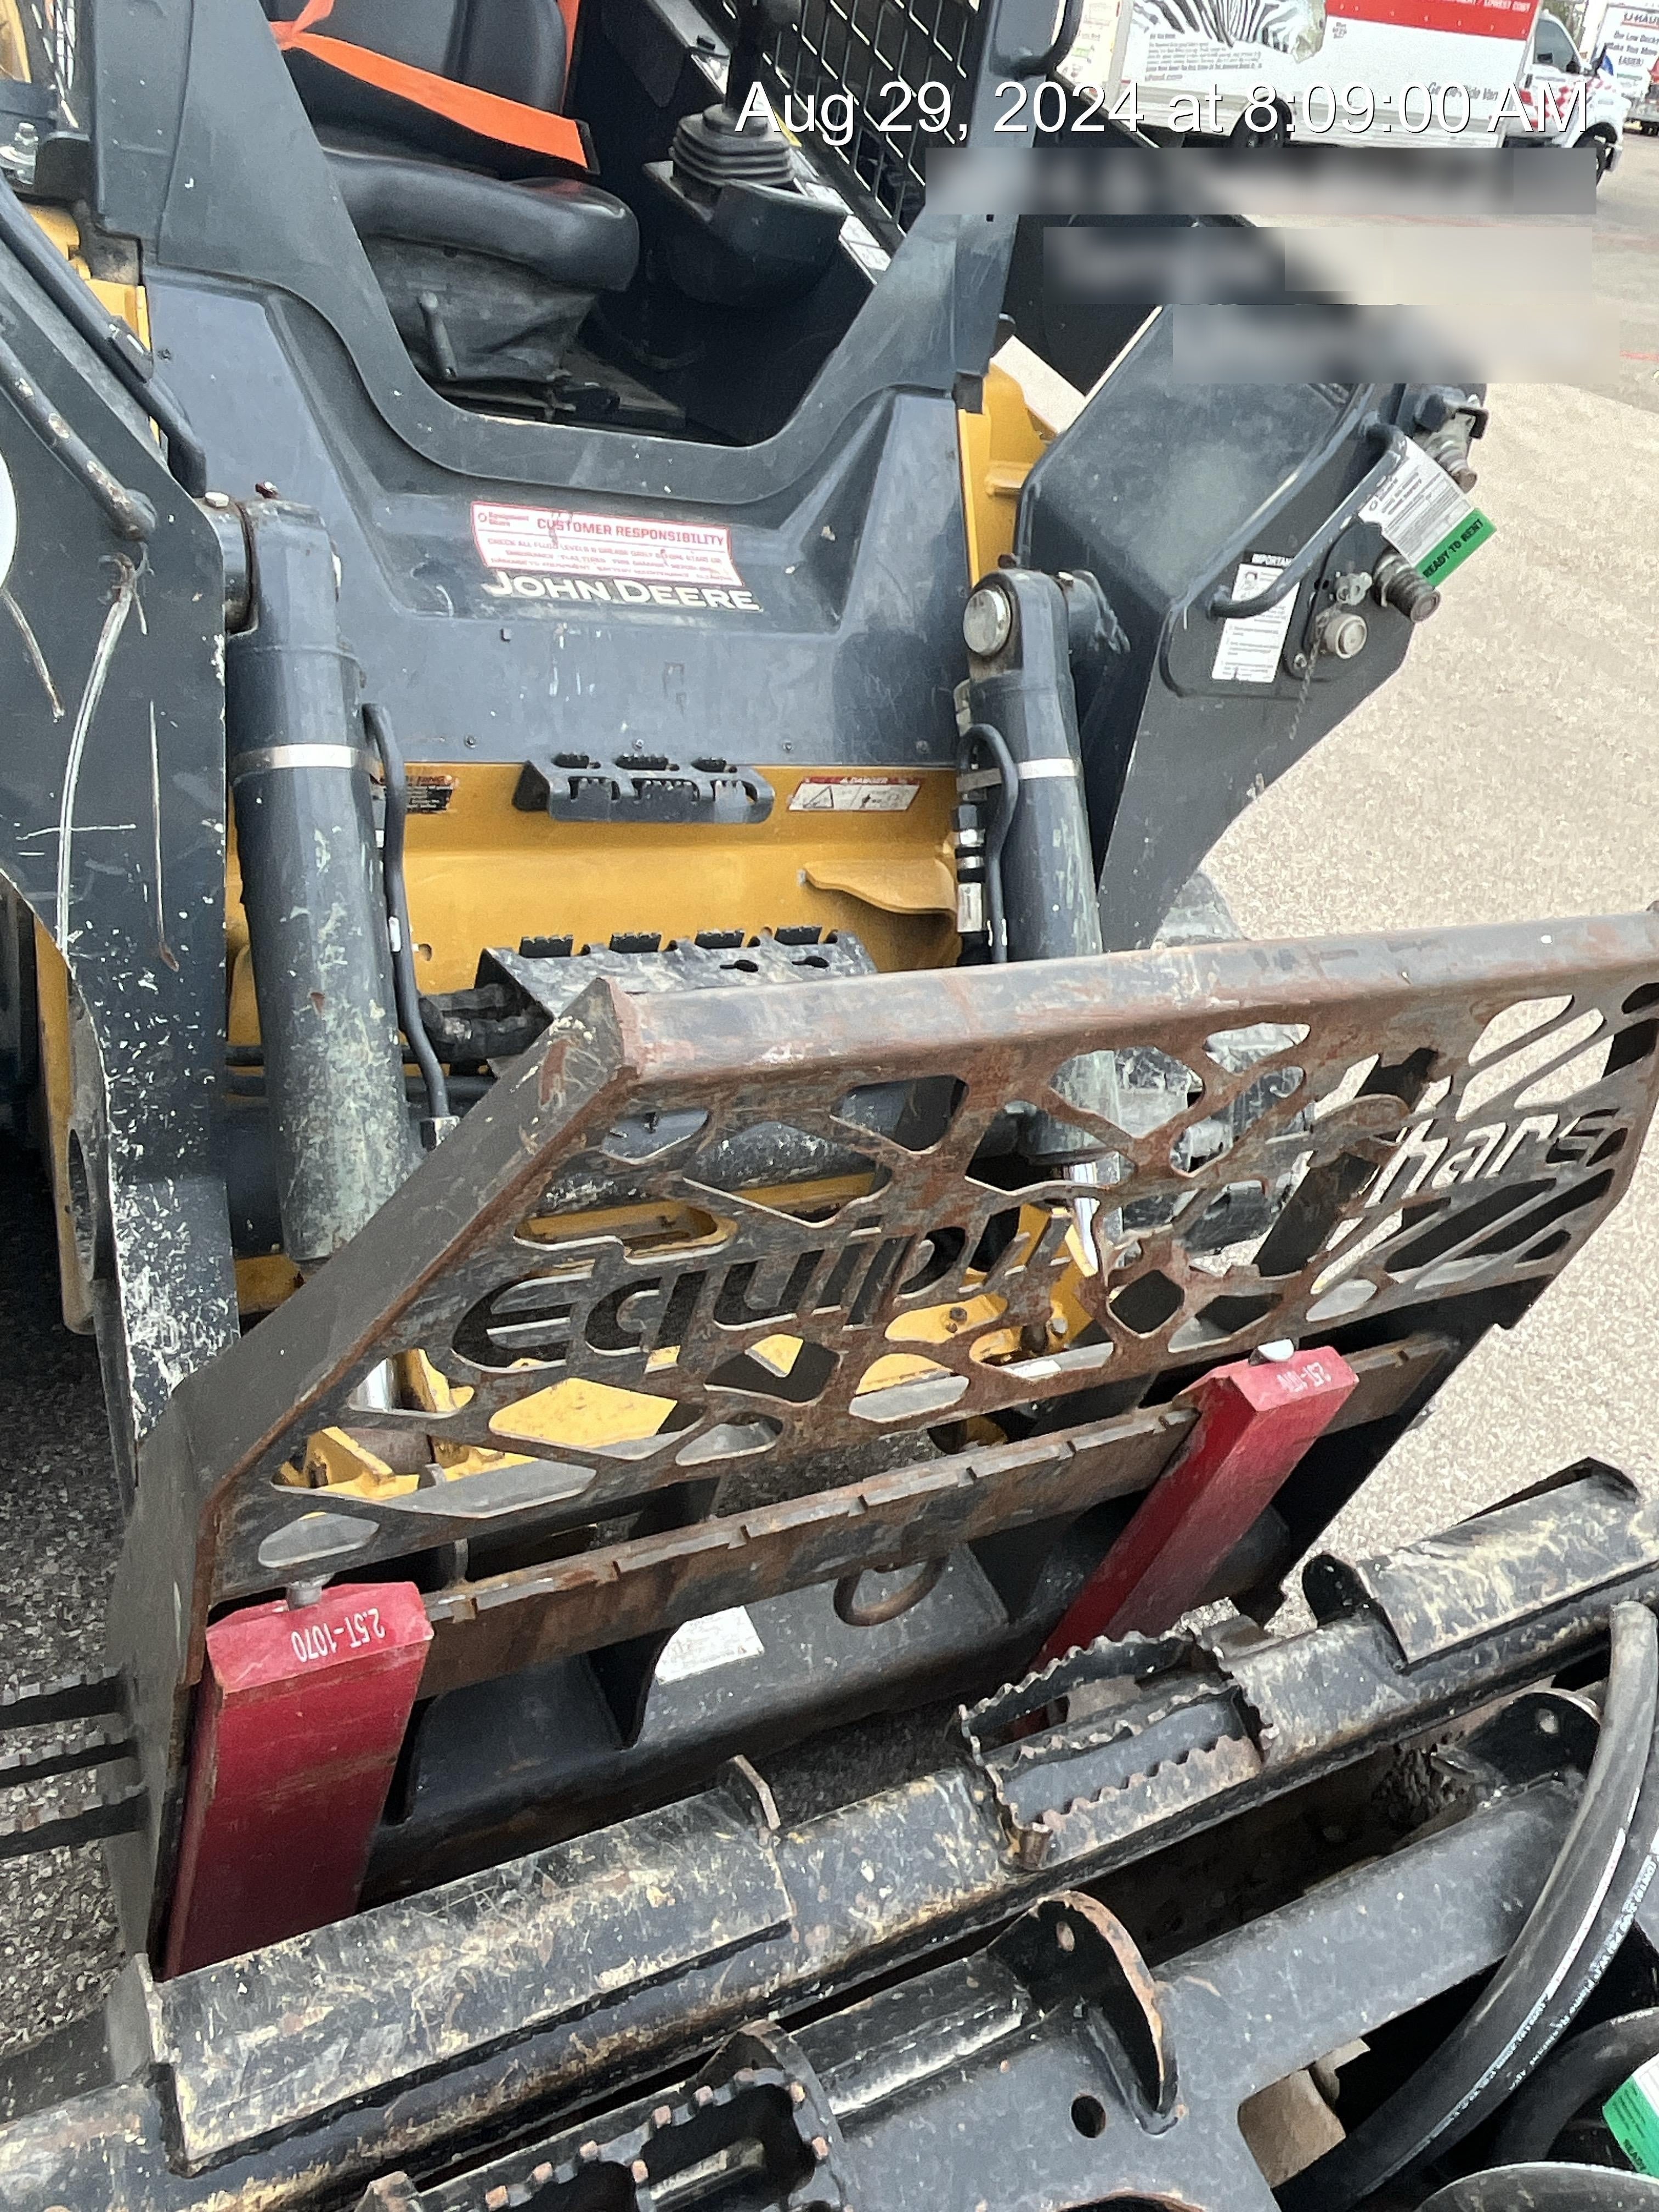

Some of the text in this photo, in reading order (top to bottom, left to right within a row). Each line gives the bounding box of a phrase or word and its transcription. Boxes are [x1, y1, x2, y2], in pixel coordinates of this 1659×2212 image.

[537, 518, 724, 546] CUSTOMER RESPONSIBILITY
[1422, 518, 1483, 578] READY TO RENT
[482, 571, 612, 602] JOHN
[613, 579, 761, 611] DEERE
[291, 1607, 386, 1663] 2.5T-1070
